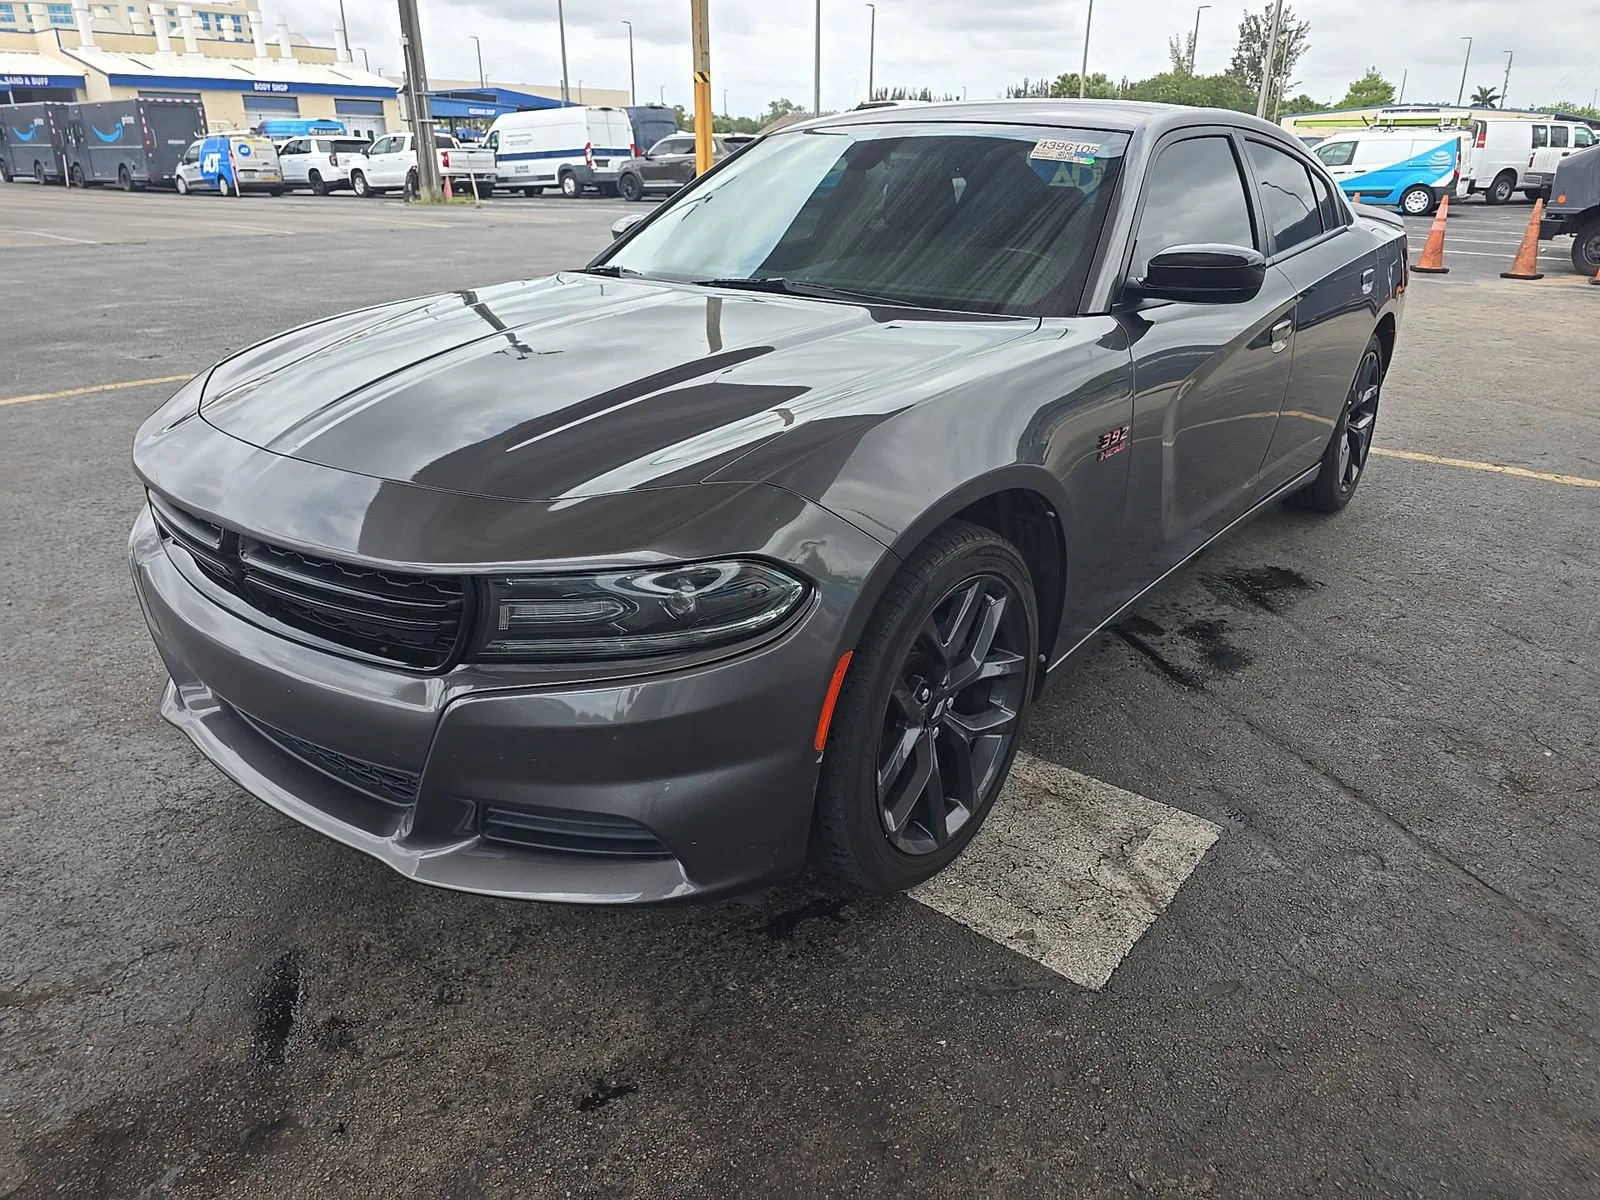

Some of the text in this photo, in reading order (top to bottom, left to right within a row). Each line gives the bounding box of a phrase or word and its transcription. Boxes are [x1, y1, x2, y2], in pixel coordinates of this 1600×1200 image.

[4, 76, 49, 86] SAND & BUFF
[253, 82, 288, 92] BODY SHOP
[1039, 141, 1100, 154] 4396105
[203, 152, 222, 174] ADT
[1101, 426, 1130, 449] 392
